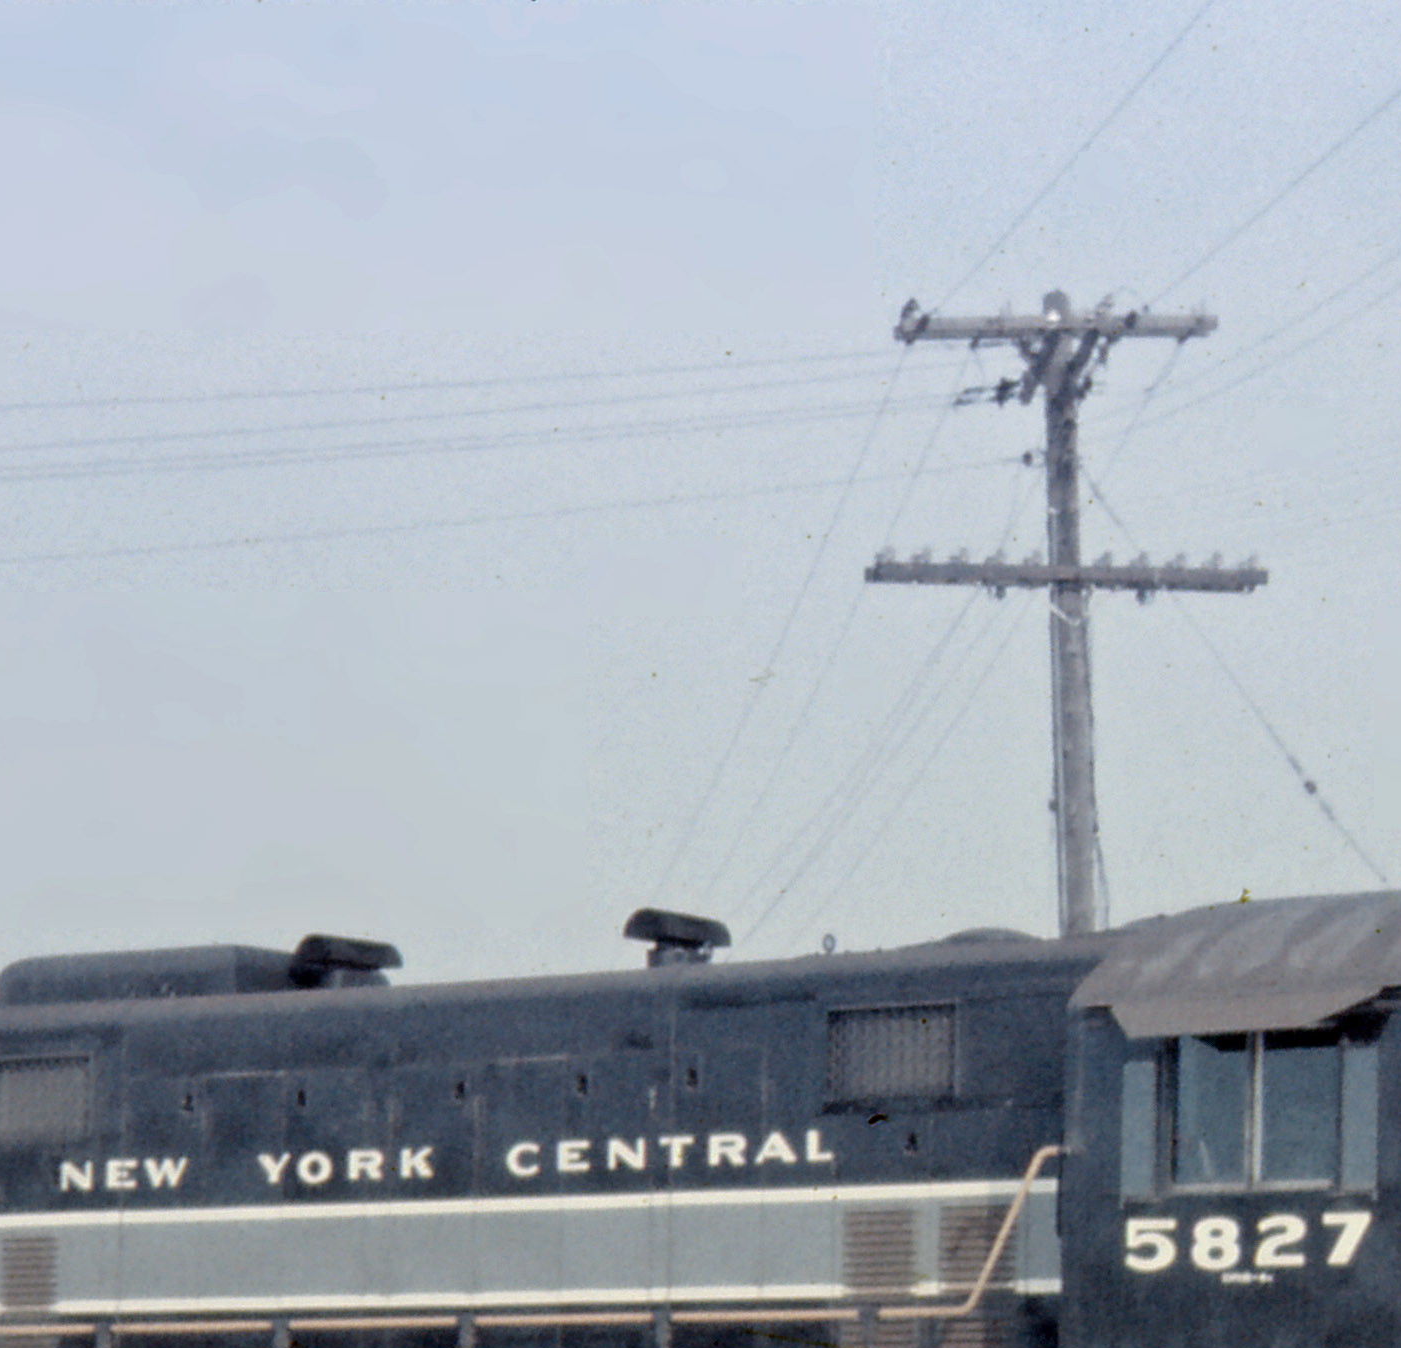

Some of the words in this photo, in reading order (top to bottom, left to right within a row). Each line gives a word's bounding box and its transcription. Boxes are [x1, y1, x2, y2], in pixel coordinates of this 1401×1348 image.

[61, 1157, 187, 1190] NEW
[258, 1146, 433, 1184] YORK
[506, 1129, 834, 1177] CENTRAL
[1124, 1210, 1371, 1272] 5827
